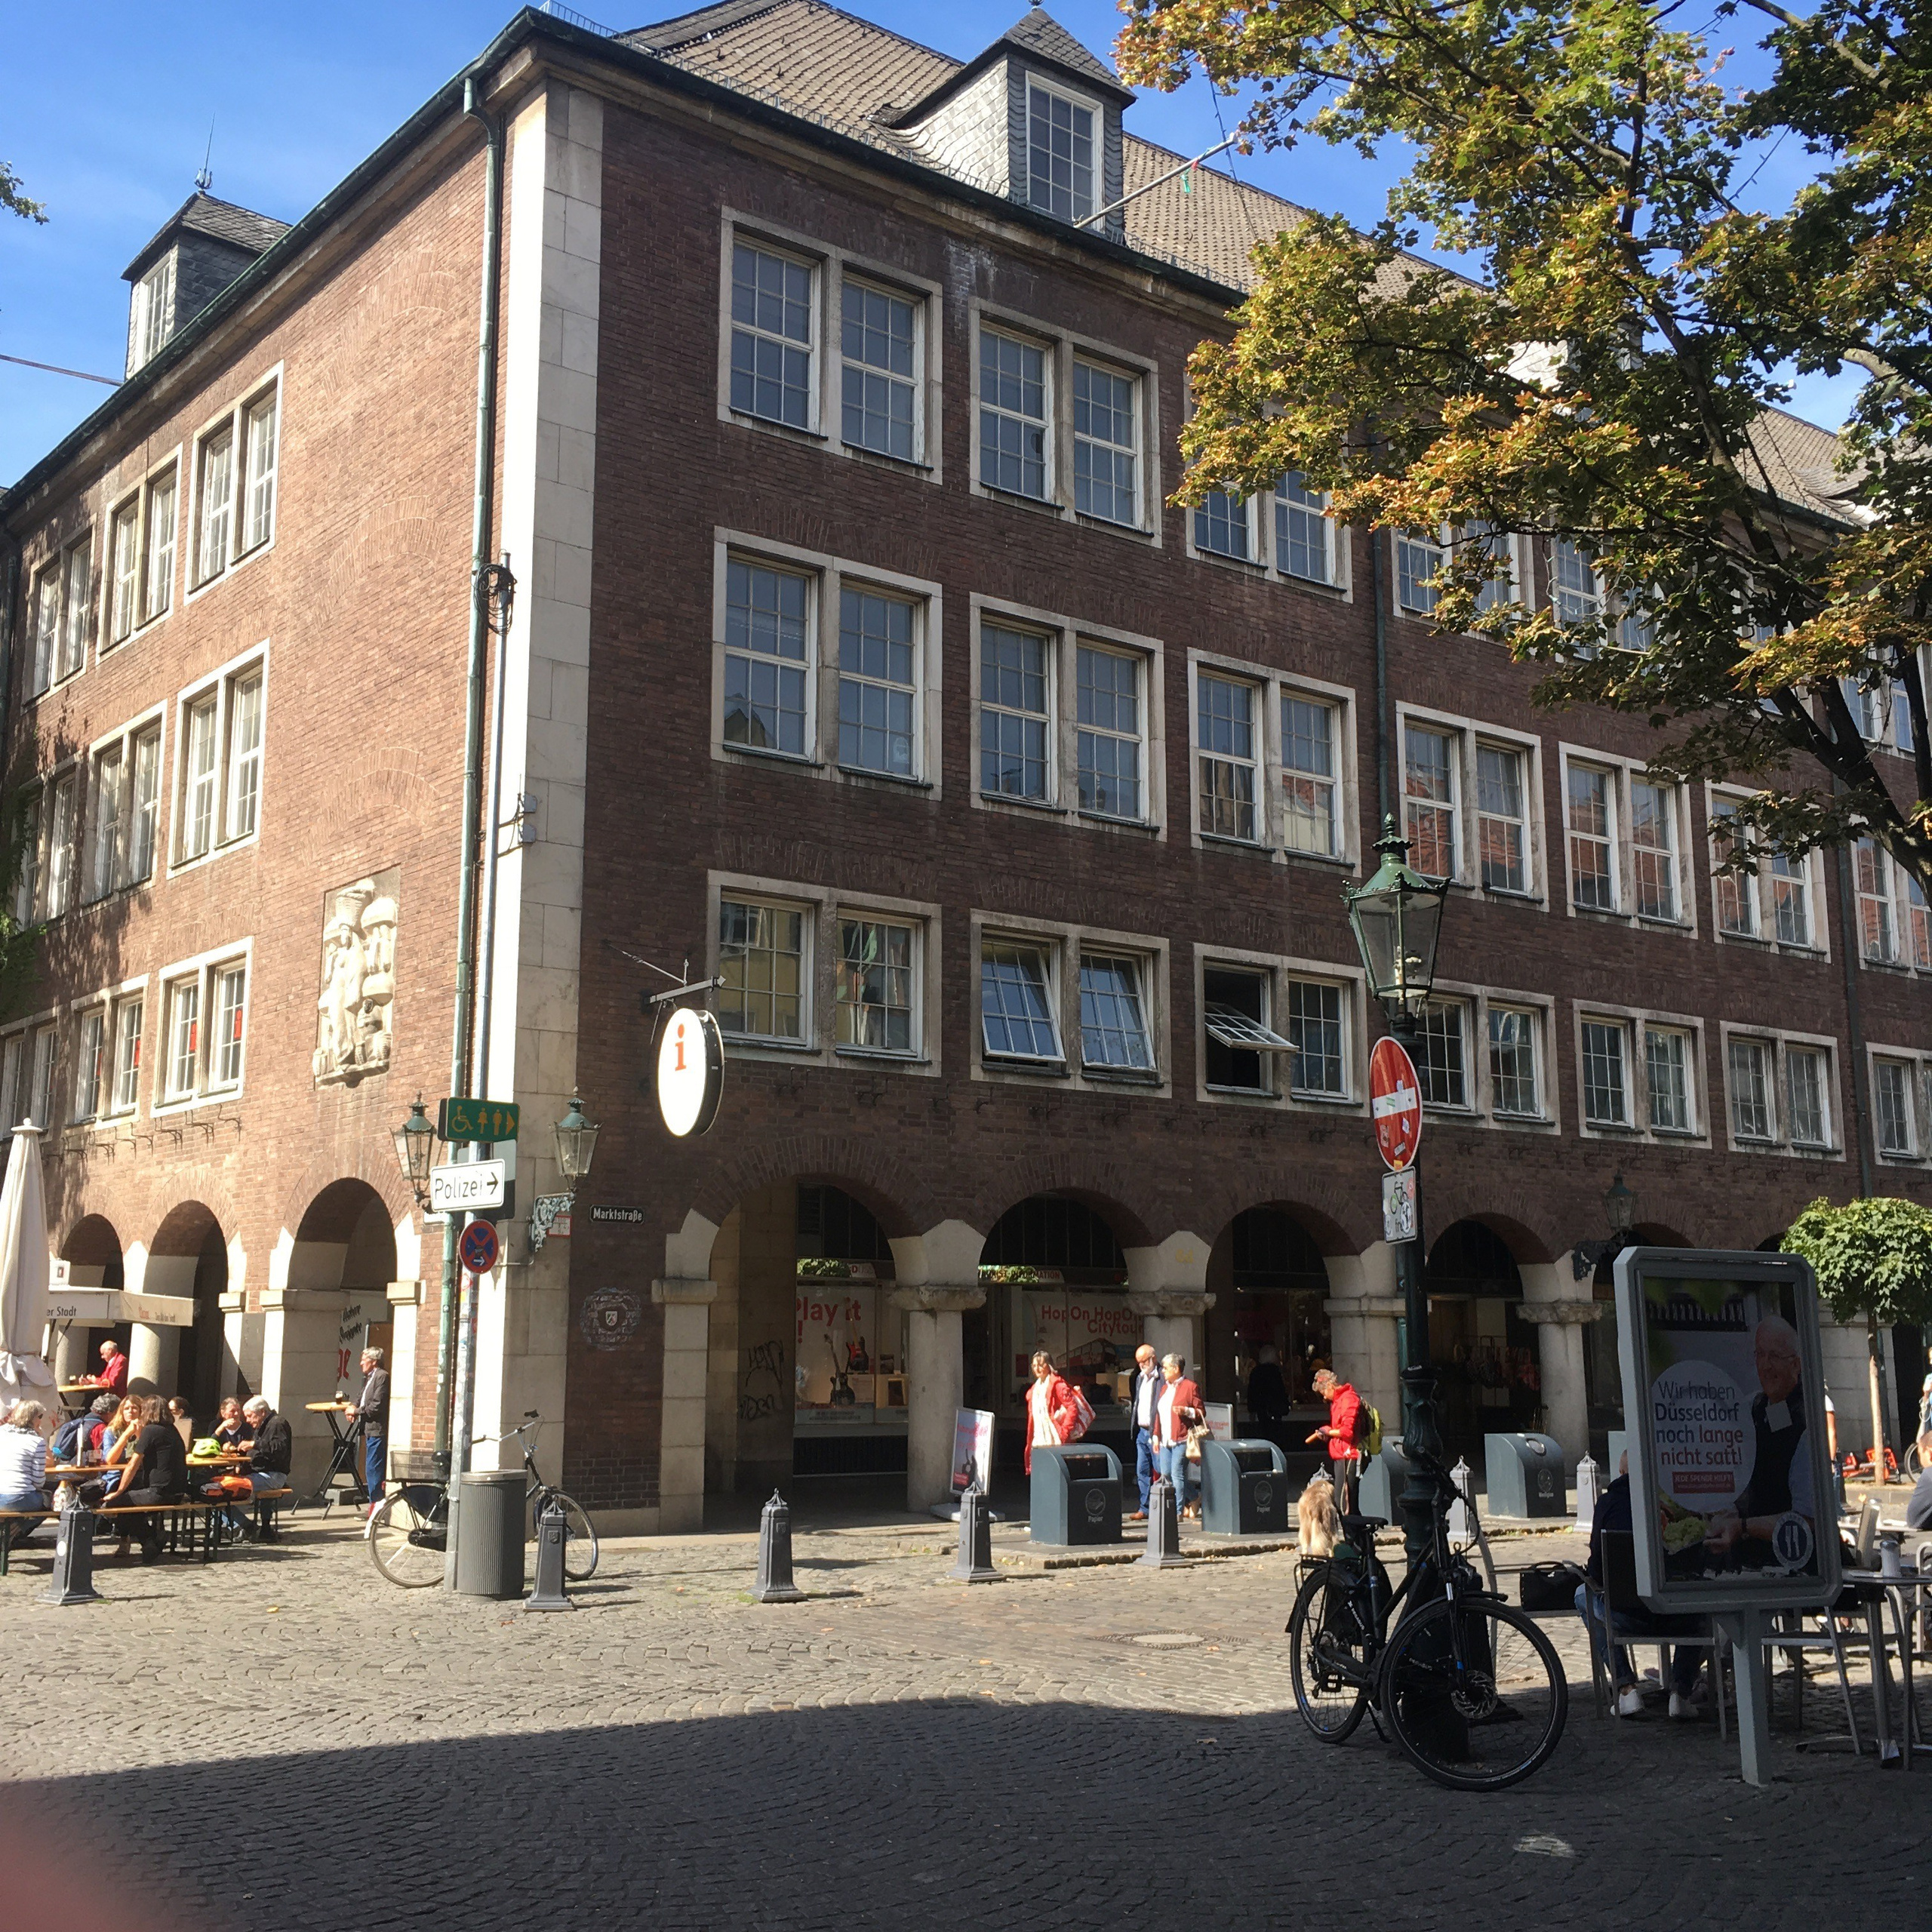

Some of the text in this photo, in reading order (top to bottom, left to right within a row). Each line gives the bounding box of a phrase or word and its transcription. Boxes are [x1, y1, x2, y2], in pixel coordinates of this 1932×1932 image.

[434, 1177, 483, 1200] Polizei
[594, 1208, 641, 1223] Marktstraße
[57, 1306, 77, 1317] Stadt
[1658, 1381, 1736, 1400] Wir haben
[1654, 1402, 1740, 1422] Düsseldorf
[1656, 1424, 1743, 1448] noch lange
[1661, 1447, 1743, 1466] nicht satt!
[1690, 1474, 1712, 1482] SPENDE
